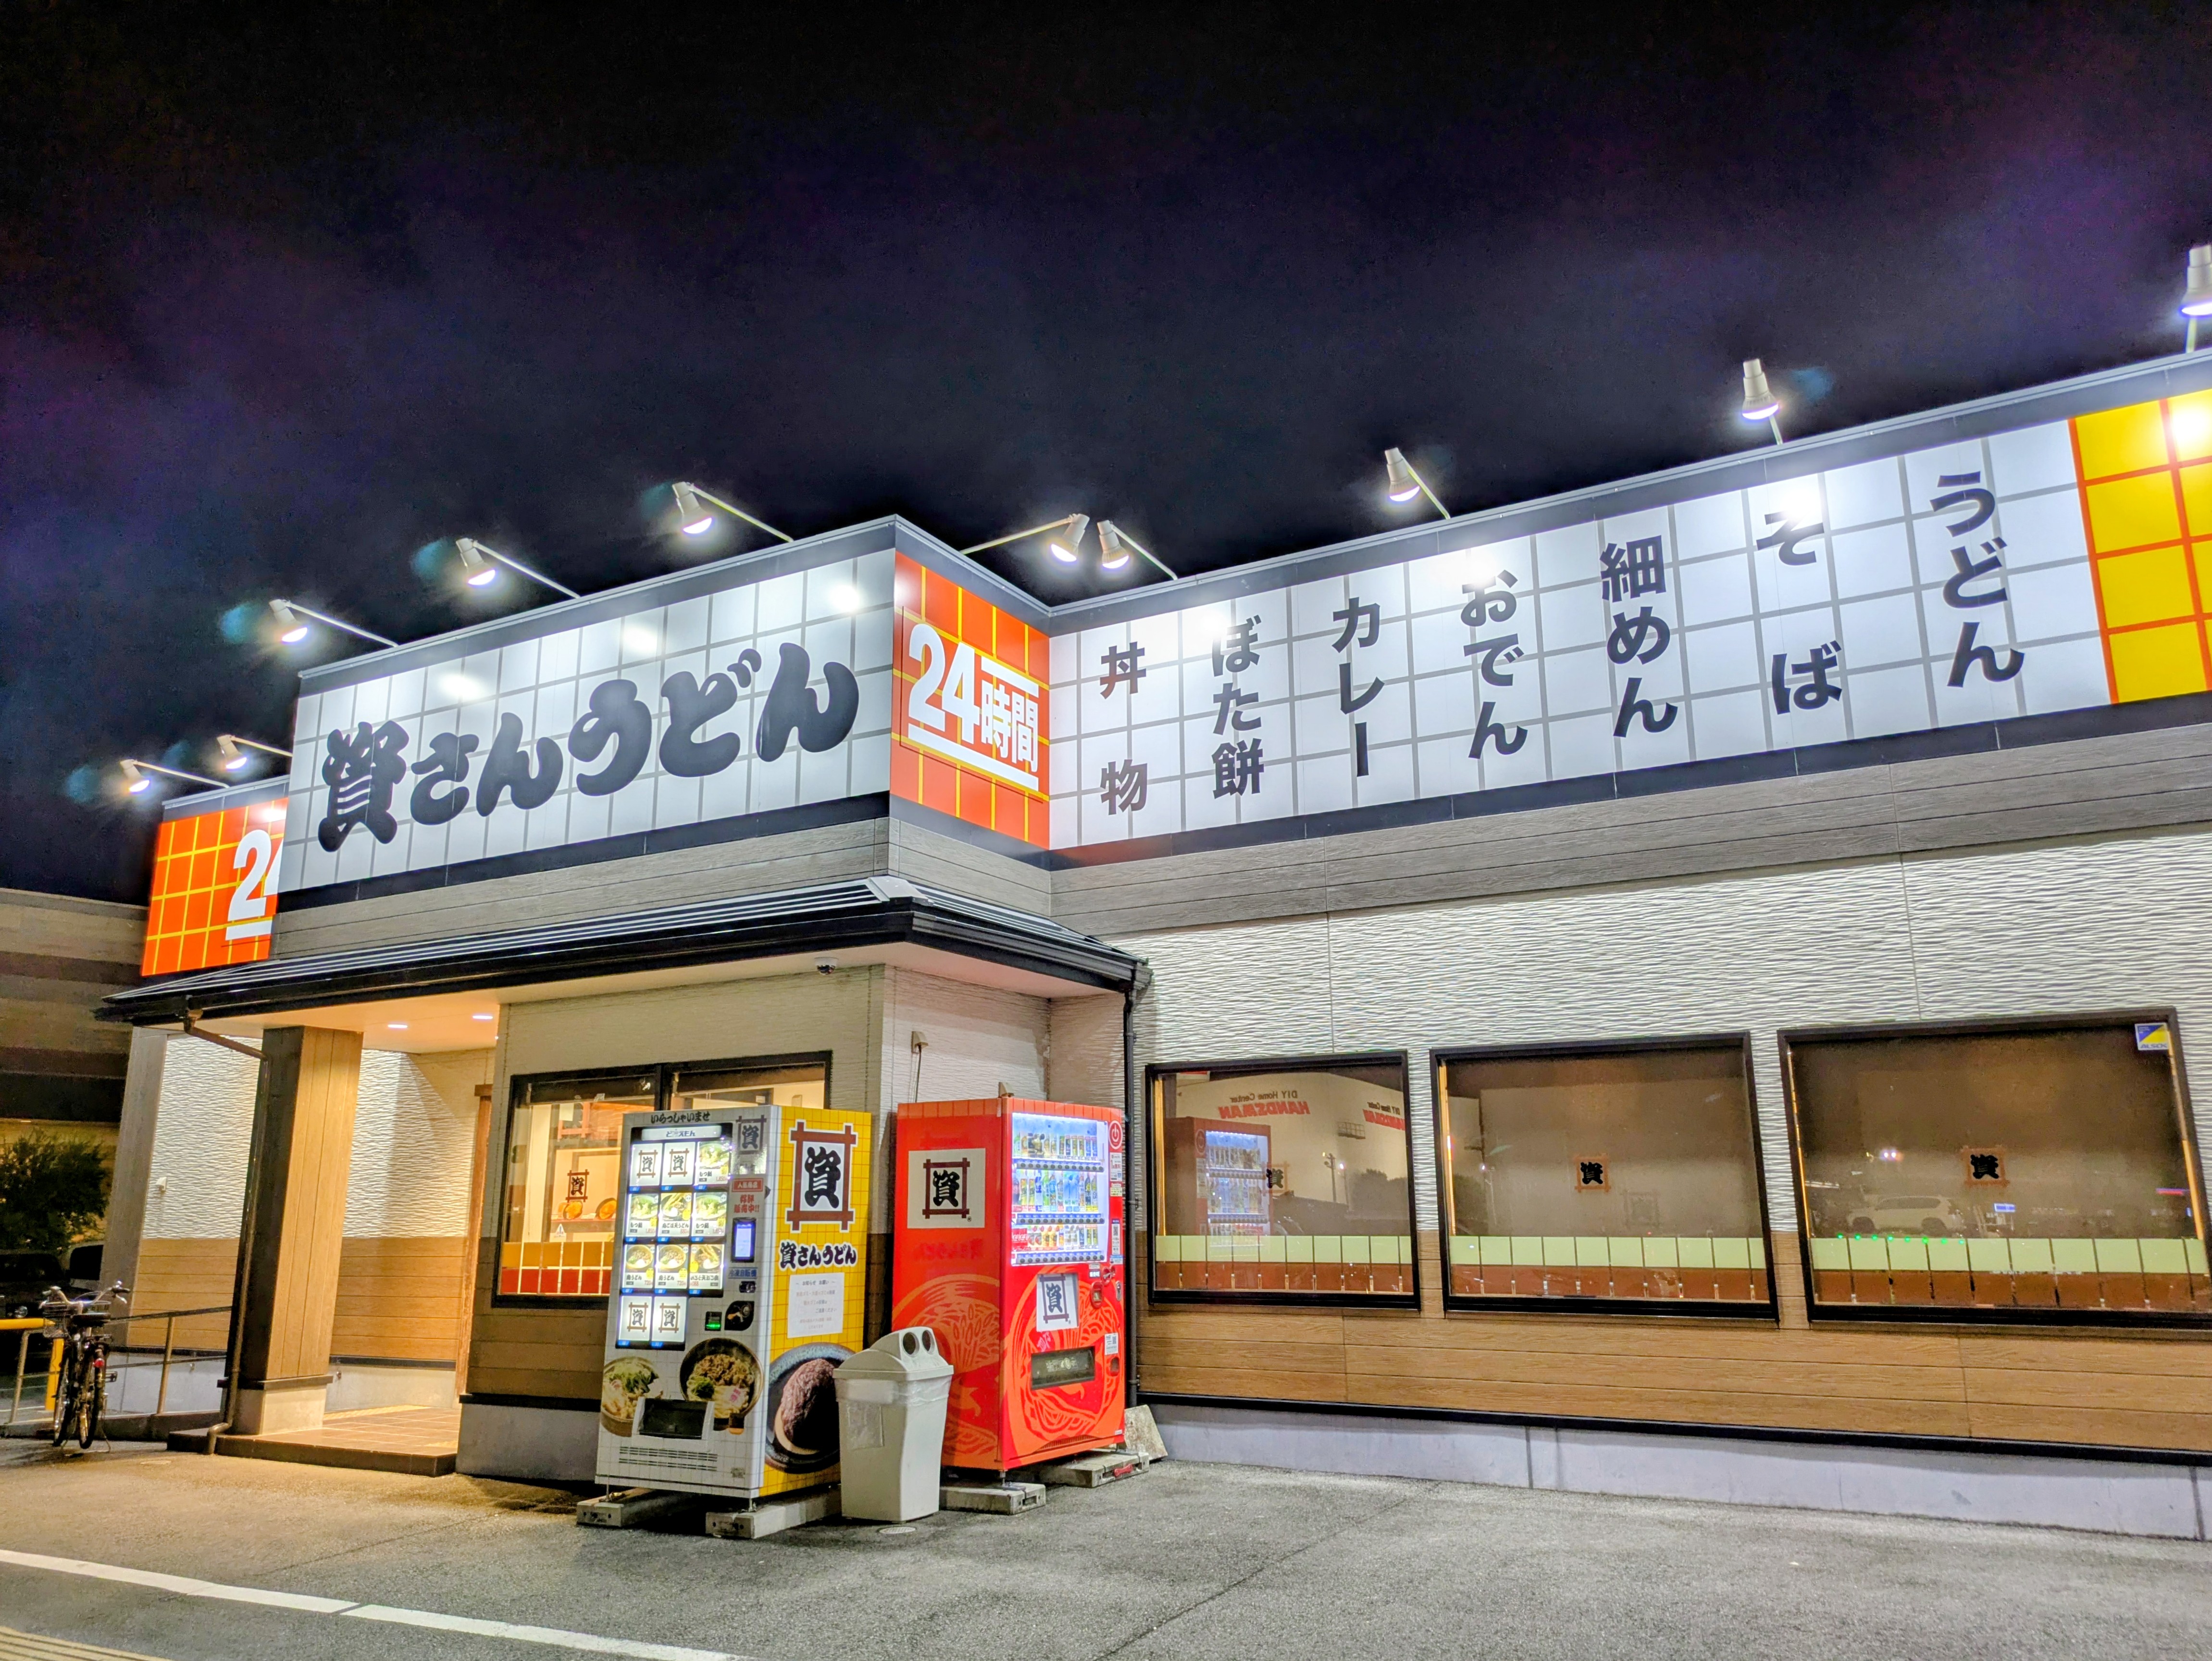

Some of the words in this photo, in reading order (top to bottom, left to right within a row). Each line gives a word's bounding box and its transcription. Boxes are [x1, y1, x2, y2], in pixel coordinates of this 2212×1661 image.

[1600, 535, 1678, 738] 細めん
[1756, 510, 1842, 714] そば
[1929, 471, 2025, 687] うどん
[908, 624, 1038, 773] 24時間
[1211, 614, 1264, 799] ぼた餅
[1332, 597, 1384, 777] カレー
[1460, 569, 1528, 759] おでん
[318, 643, 859, 852] 資さんうどん
[651, 1111, 710, 1124] いらっしゃいませ
[742, 1124, 759, 1149] 資
[804, 1146, 842, 1209] 資
[933, 1170, 960, 1207] 資
[780, 1243, 857, 1269] 資さんうどん
[1046, 1283, 1063, 1313] 資
